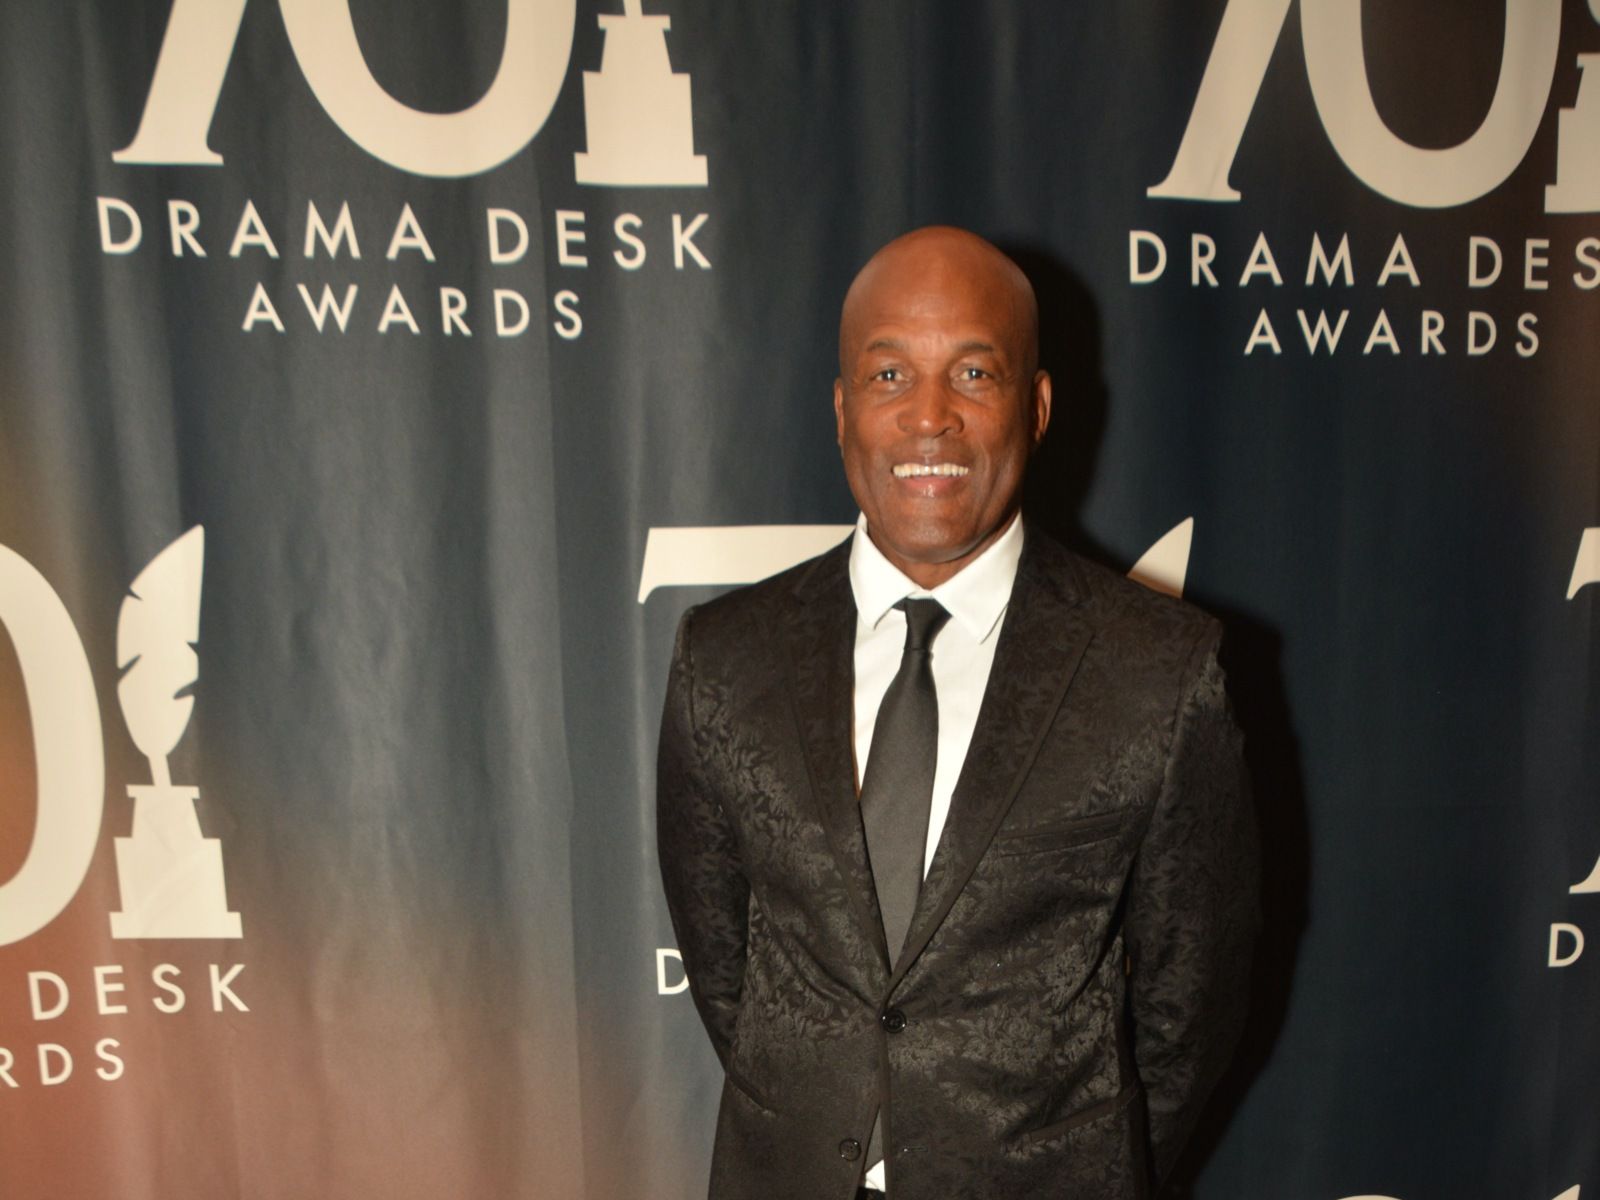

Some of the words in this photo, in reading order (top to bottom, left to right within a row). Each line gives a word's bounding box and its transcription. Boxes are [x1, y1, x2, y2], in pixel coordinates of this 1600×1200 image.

[96, 196, 436, 262] DRAMA
[486, 208, 712, 271] DESK
[1129, 230, 1421, 287] DRAMA
[242, 282, 583, 339] AWARDS
[1244, 308, 1539, 357] AWARDS
[28, 963, 250, 1021] DESK
